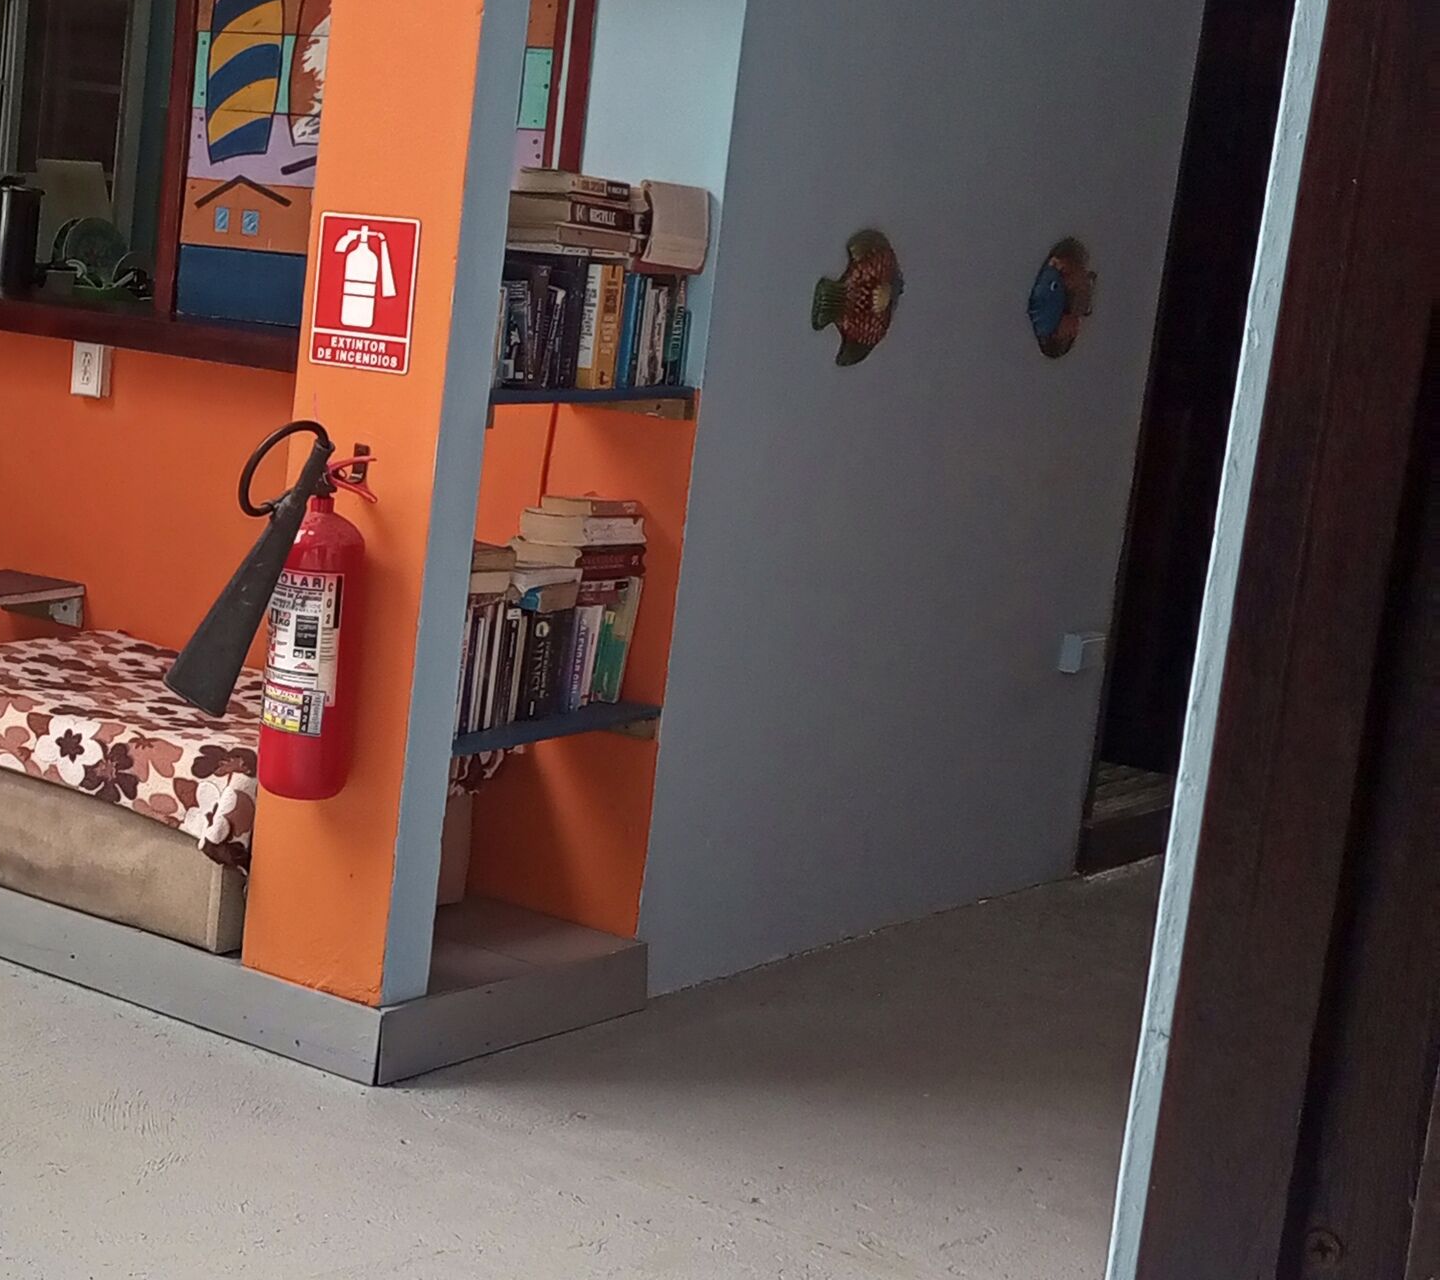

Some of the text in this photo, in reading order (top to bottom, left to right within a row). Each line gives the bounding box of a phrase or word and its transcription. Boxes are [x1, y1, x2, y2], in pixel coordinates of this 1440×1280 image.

[331, 336, 386, 352] EXTINTOR
[317, 347, 398, 368] DE INCENDIOS
[280, 572, 322, 589] OLAR
